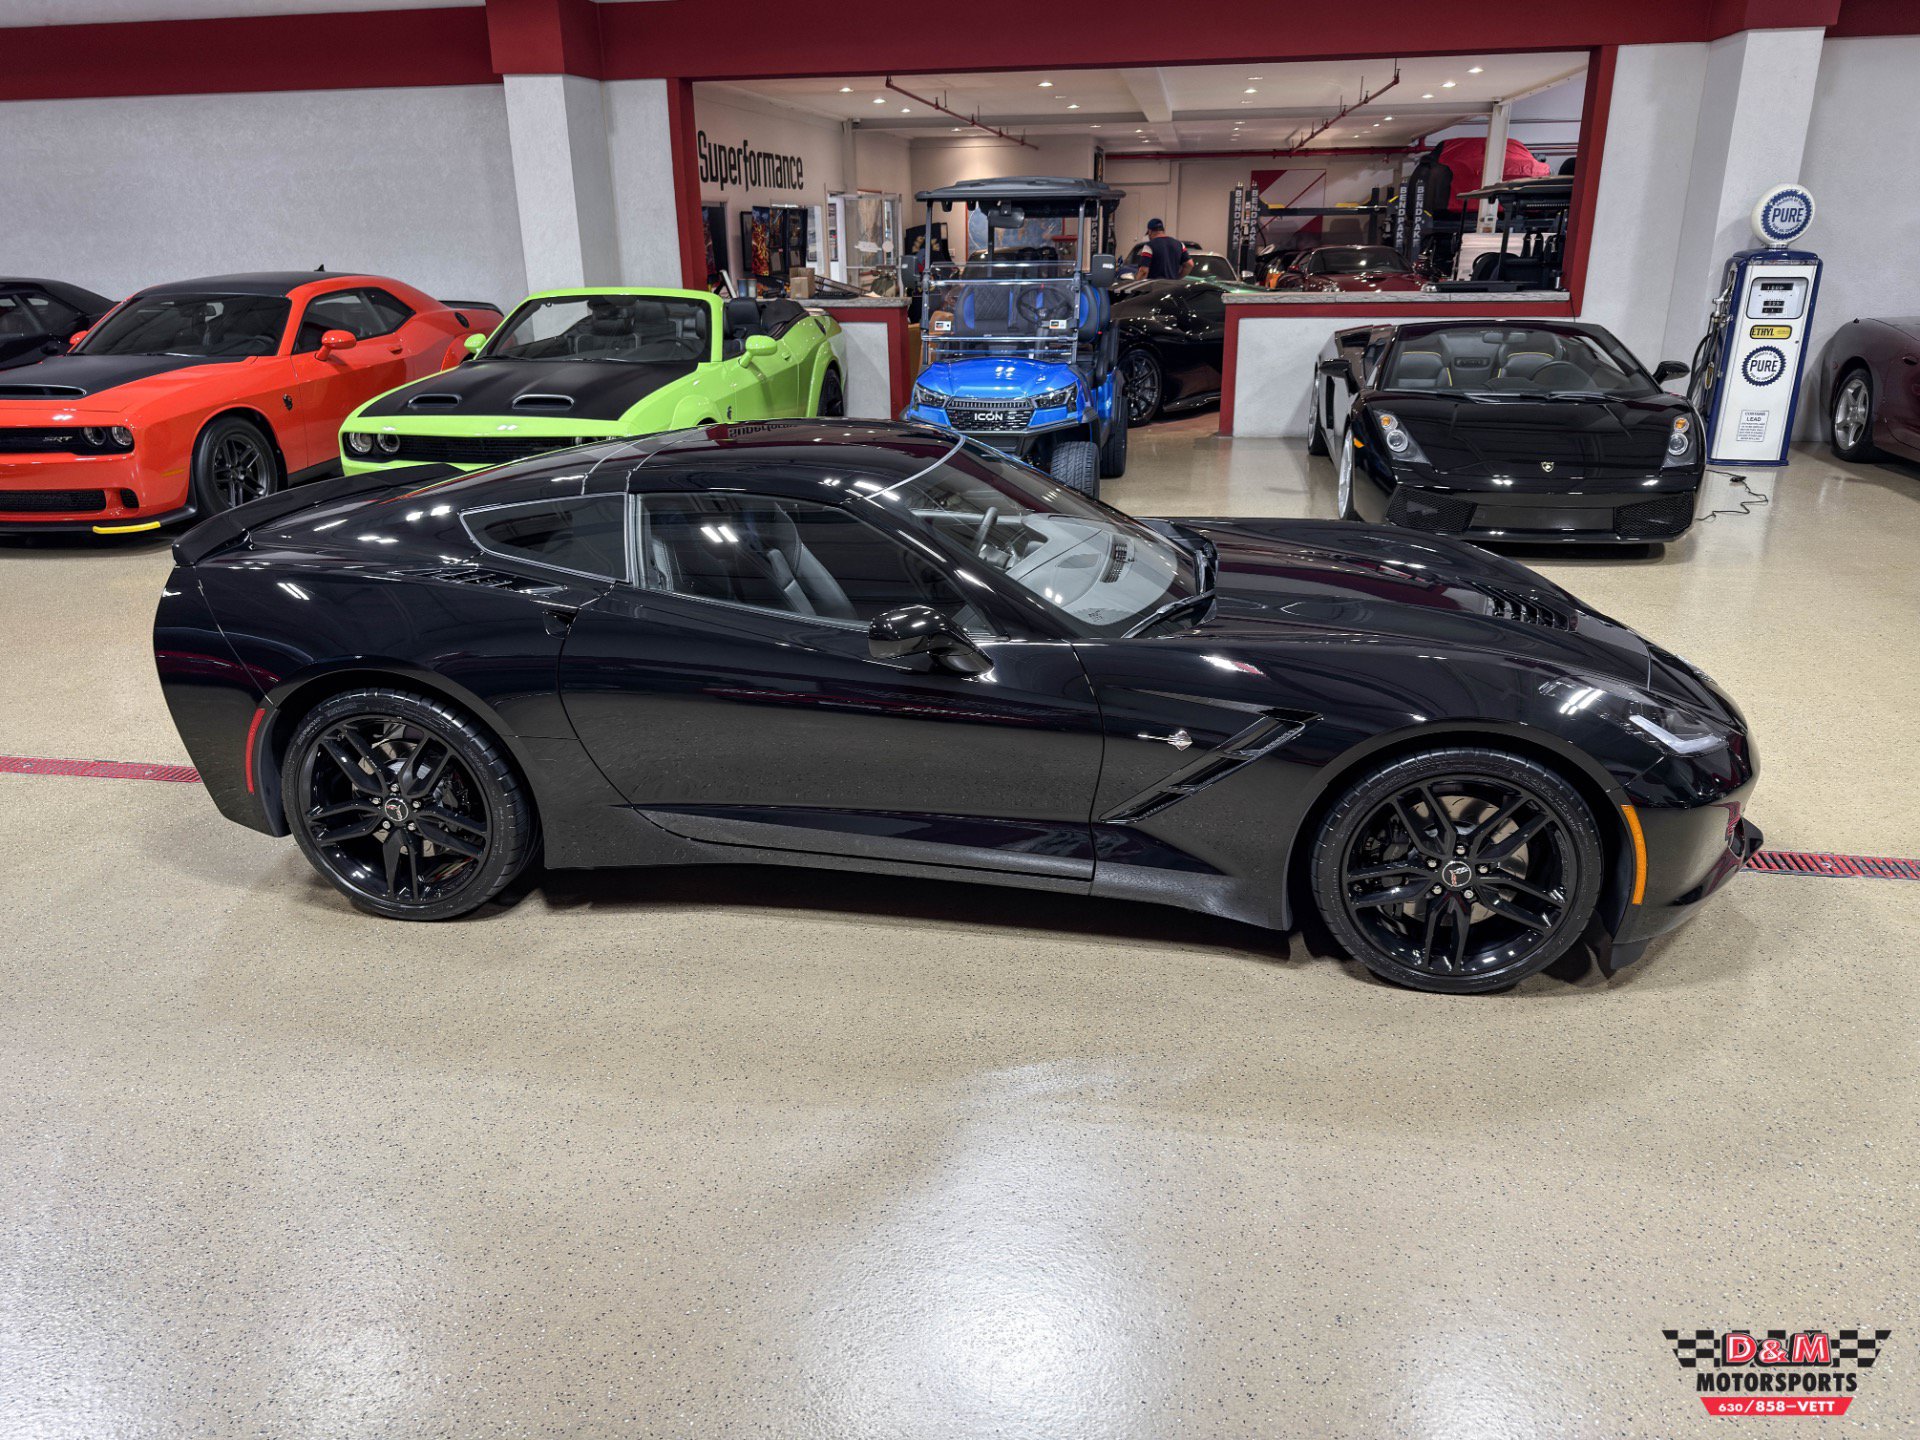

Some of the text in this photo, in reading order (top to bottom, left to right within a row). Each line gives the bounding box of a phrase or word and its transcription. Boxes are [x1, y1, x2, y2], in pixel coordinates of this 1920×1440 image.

[697, 130, 804, 192] Superformance
[1771, 207, 1805, 223] PURE
[1751, 327, 1774, 337] ETHYL
[1749, 359, 1779, 372] PURE
[974, 411, 1004, 421] ICON
